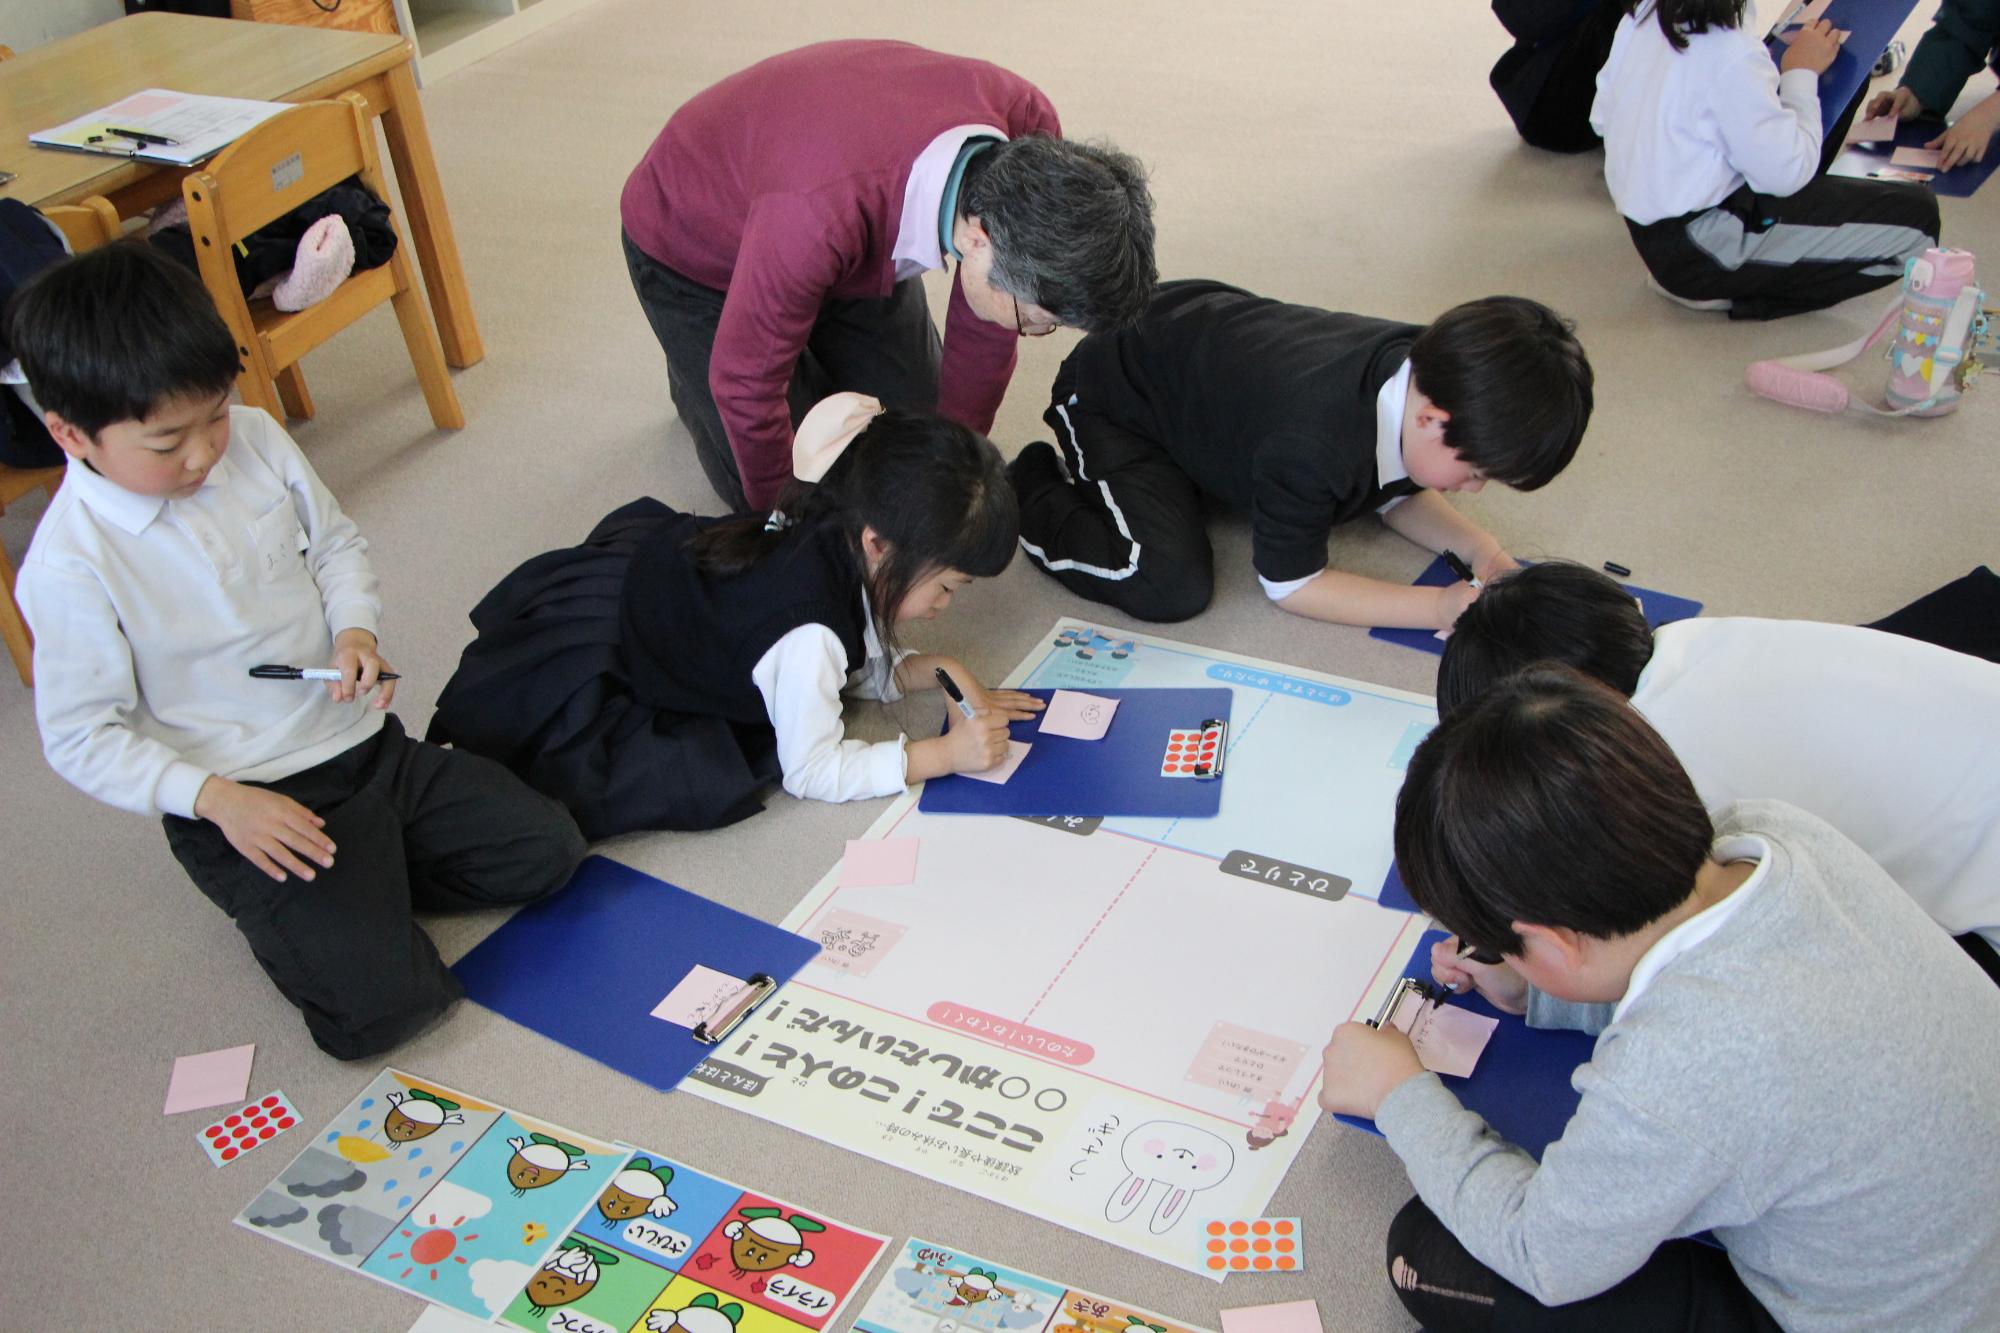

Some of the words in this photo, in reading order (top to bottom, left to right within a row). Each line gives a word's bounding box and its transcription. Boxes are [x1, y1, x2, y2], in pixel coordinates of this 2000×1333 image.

[1240, 859, 1330, 893] ひとりで
[942, 1008, 1077, 1058] たのしい！わくわく！
[734, 1033, 1045, 1153] ここで！この人と！
[1068, 1114, 1120, 1181] うさぎ
[628, 1225, 687, 1254] さびしい
[917, 1247, 954, 1267] ふゆ
[769, 1279, 829, 1309] イライラ
[1072, 1298, 1110, 1319] あき
